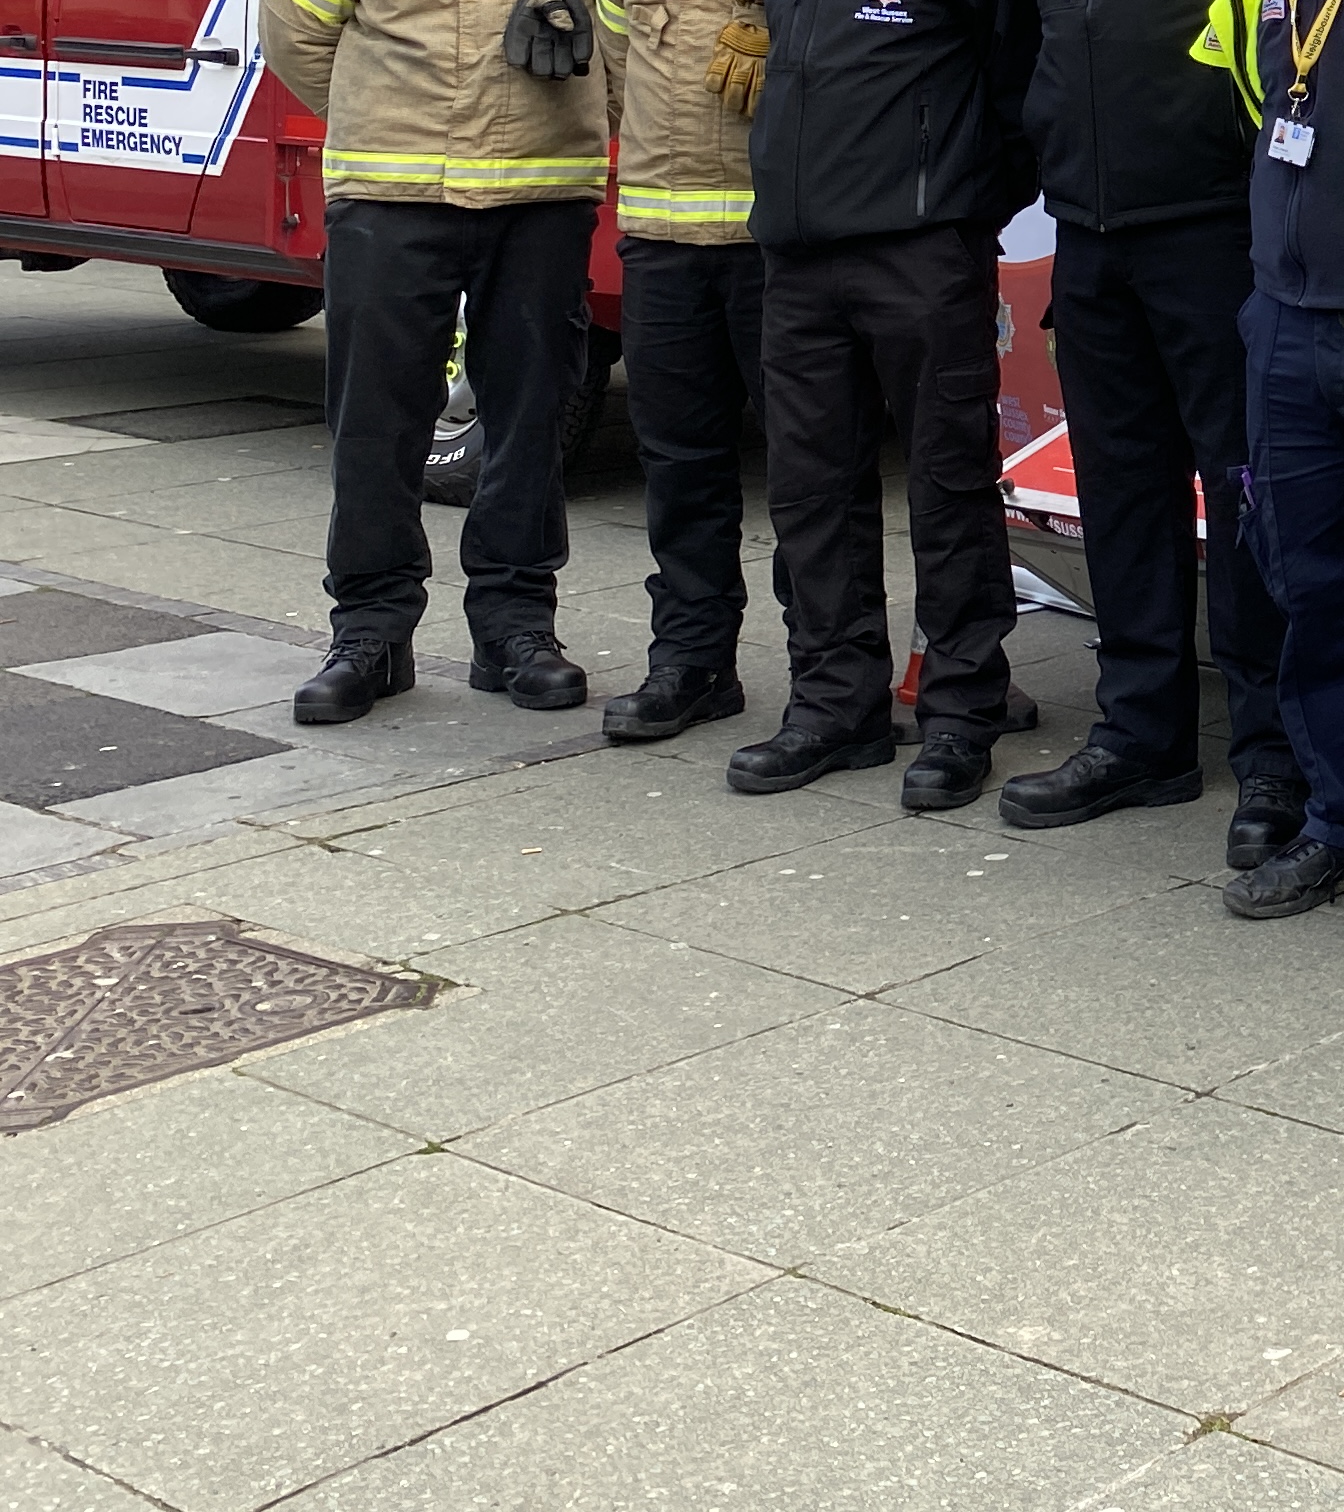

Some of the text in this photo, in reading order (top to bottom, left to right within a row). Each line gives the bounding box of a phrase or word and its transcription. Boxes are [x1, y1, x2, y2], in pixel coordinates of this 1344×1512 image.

[83, 80, 119, 101] FIRE
[83, 104, 148, 127] RESCUE
[81, 128, 183, 156] EMERGENCY
